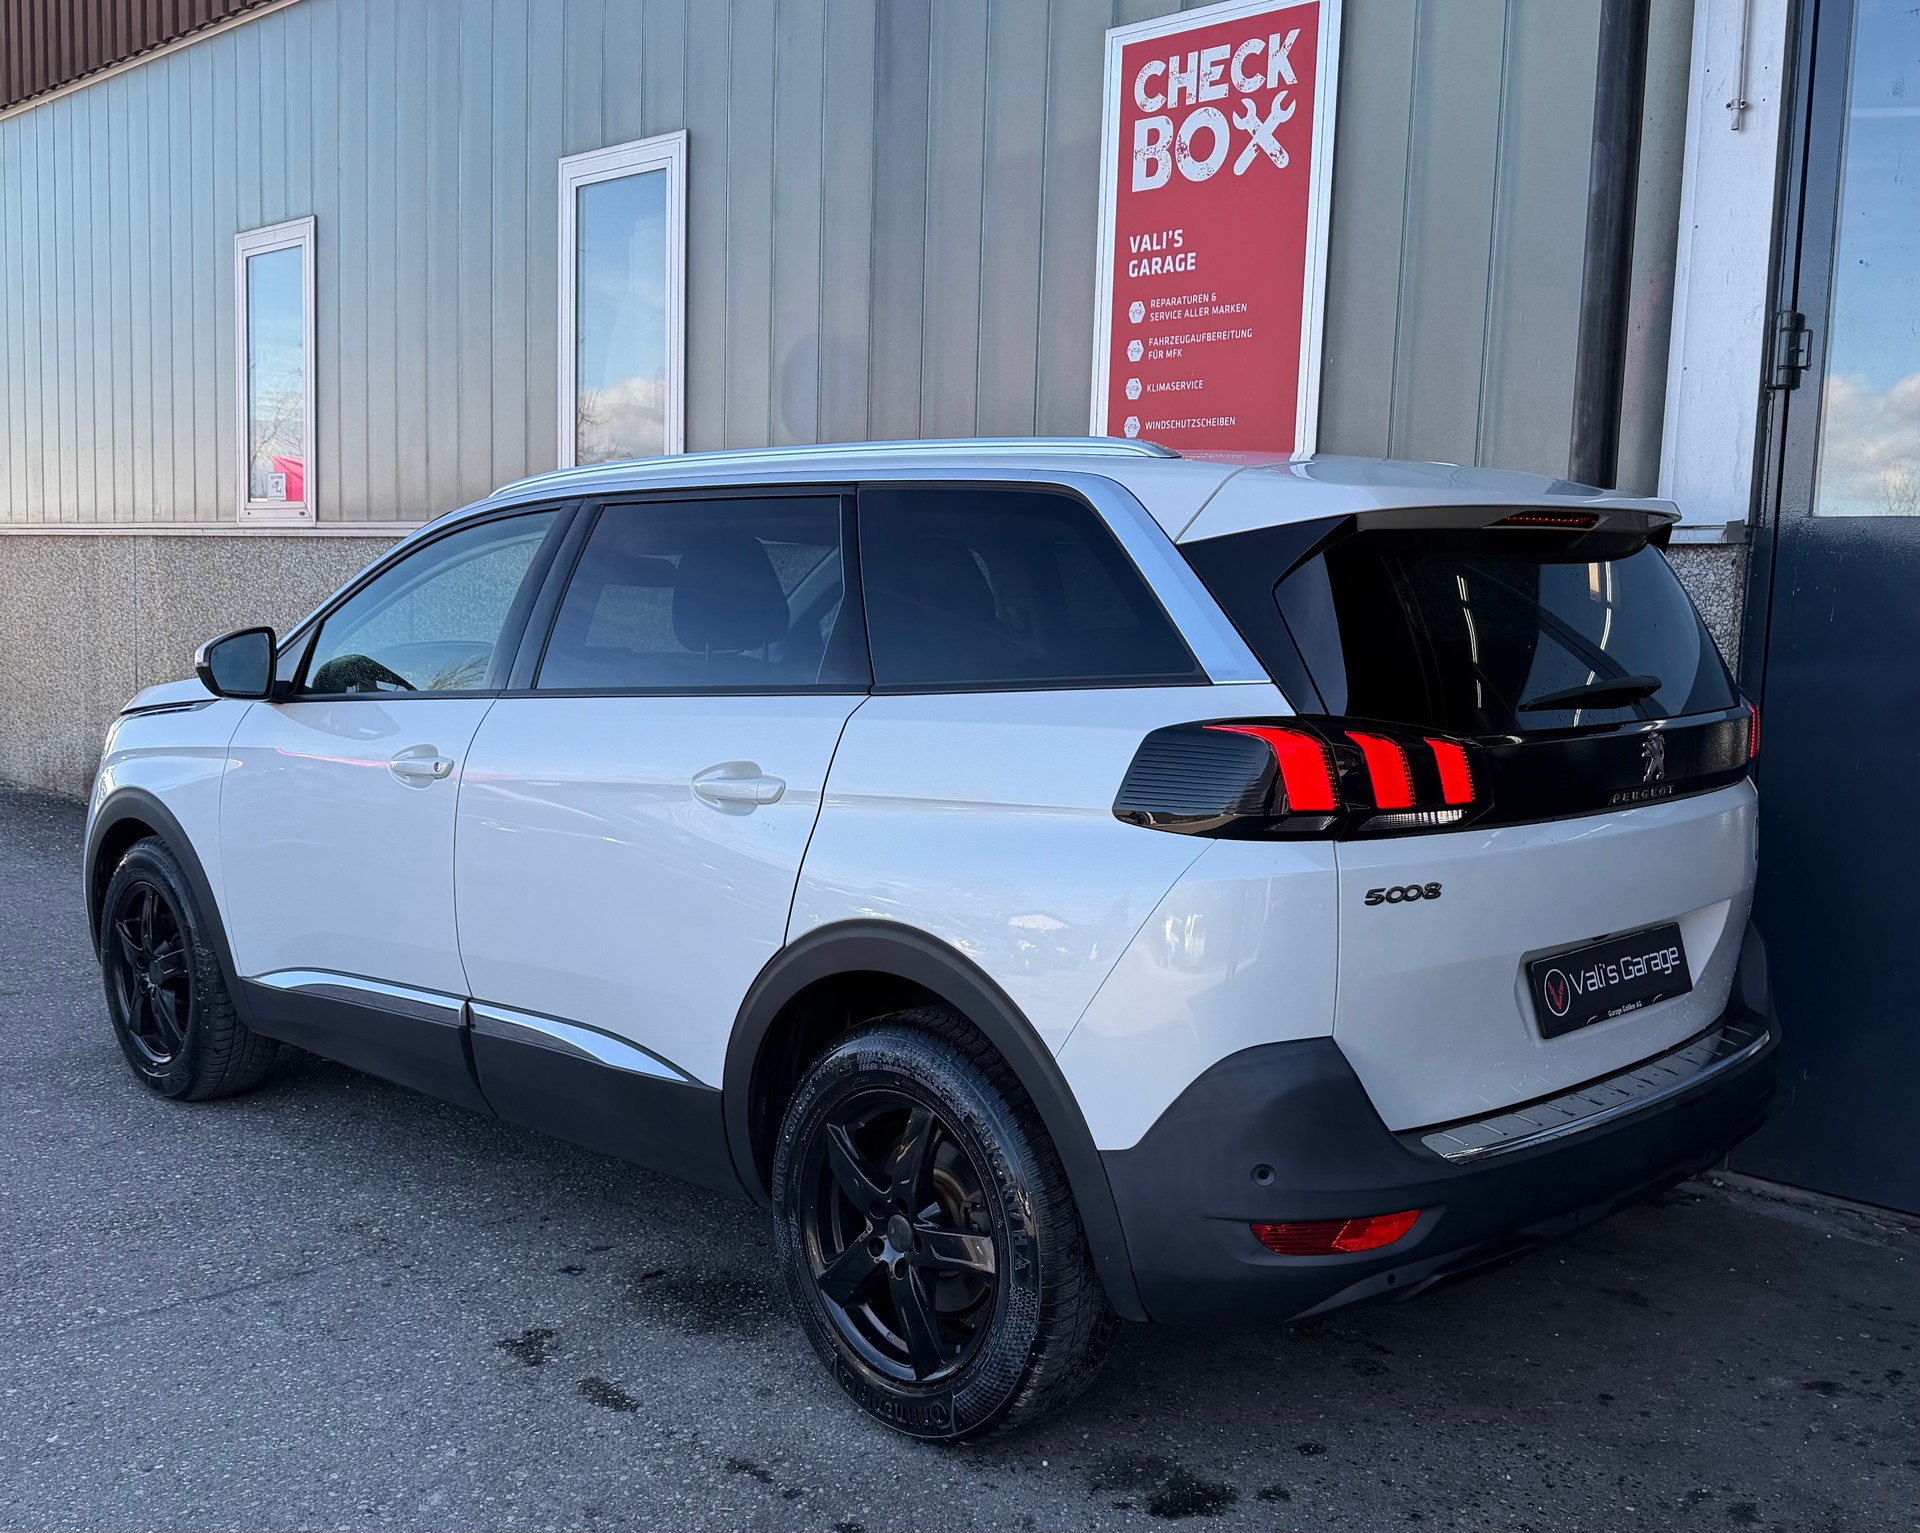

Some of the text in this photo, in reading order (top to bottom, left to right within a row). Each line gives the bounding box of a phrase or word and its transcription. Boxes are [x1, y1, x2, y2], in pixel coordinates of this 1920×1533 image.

[1133, 28, 1301, 113] CHECK
[1132, 90, 1297, 193] BOX
[1129, 229, 1184, 253] VALI'S
[1128, 252, 1197, 278] GARAGE
[1150, 292, 1217, 308] REPARATUREN &
[1150, 303, 1248, 322] SERVICE ALLER MARKEN
[1148, 328, 1253, 347] FAHRZEUGAUFBEREITUNG
[1148, 348, 1183, 360] FÜR MFK
[1146, 380, 1204, 393] KLIMASERVICE
[1145, 416, 1236, 431] WINDSCHUTZSCHEIBEN
[1612, 784, 1675, 804] PEUGEOT
[1364, 881, 1443, 906] 5008
[1569, 946, 1681, 995] Vali's Garage
